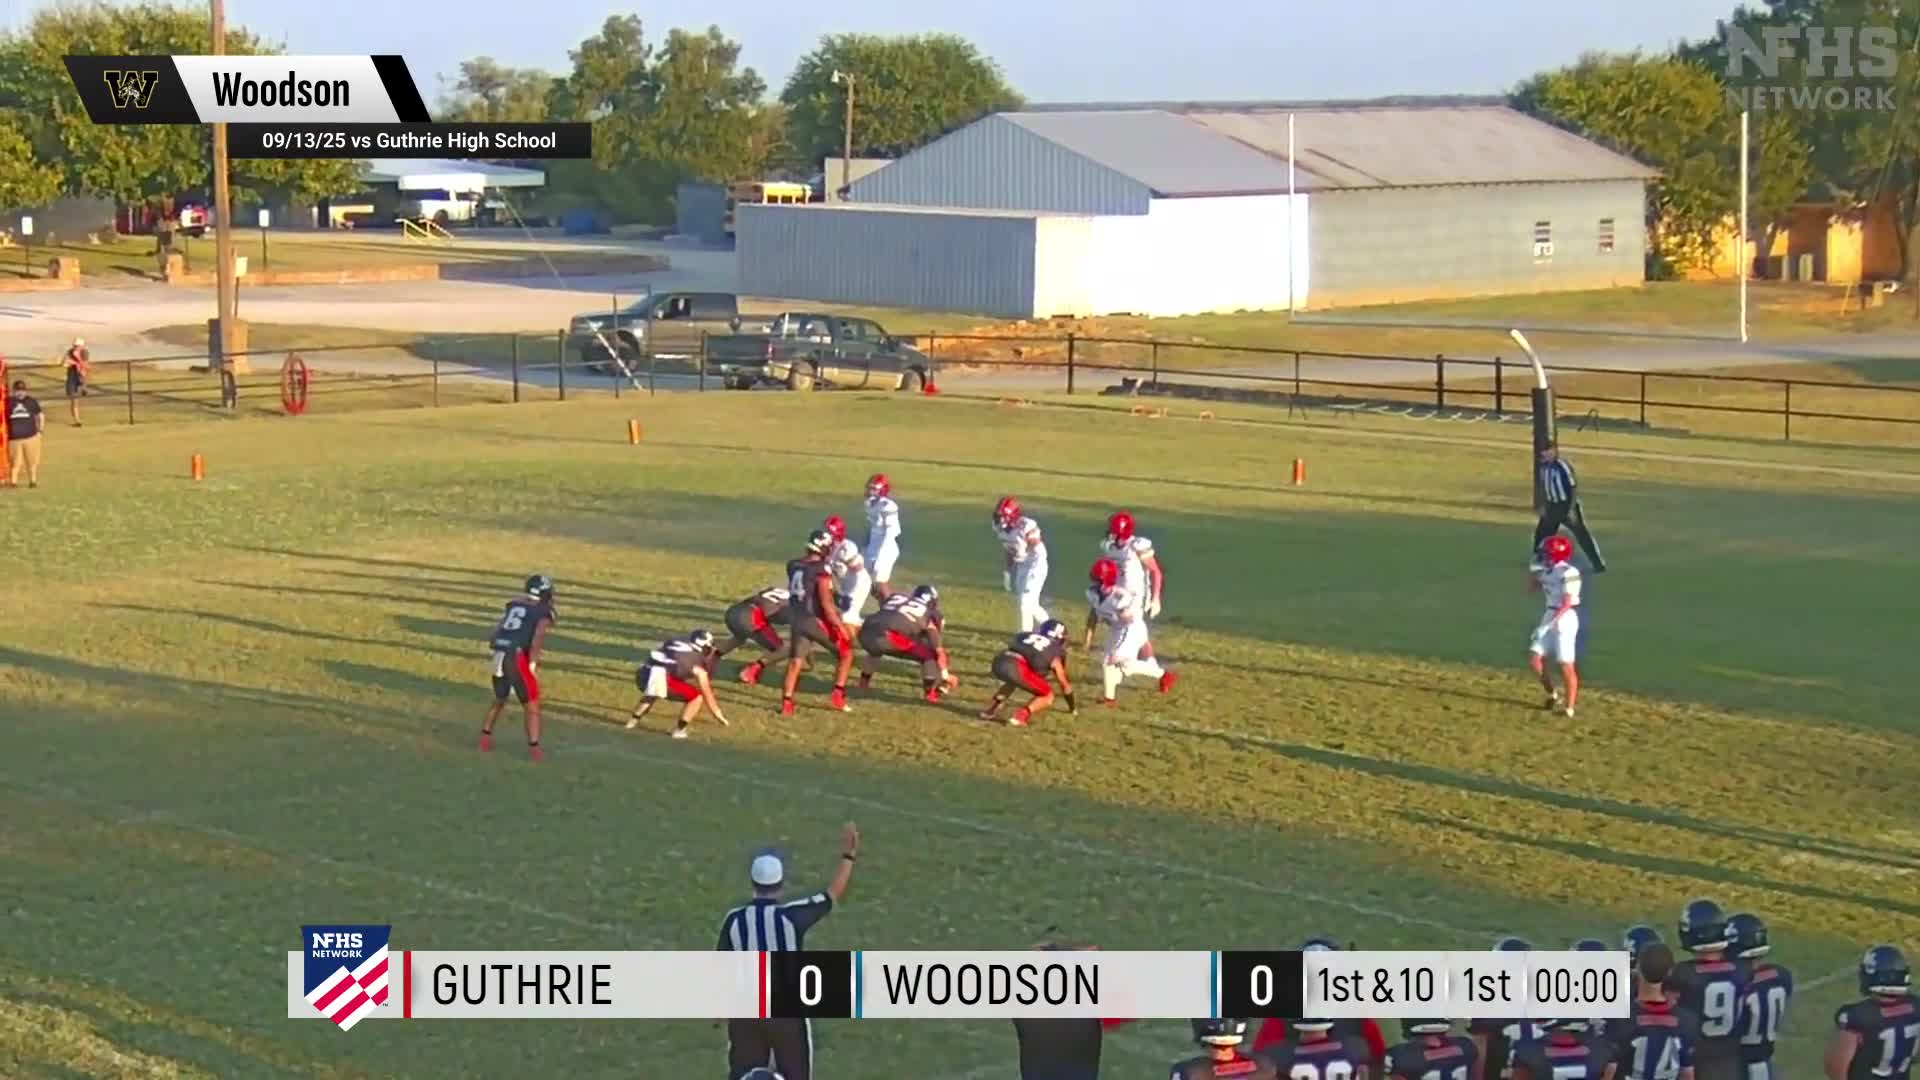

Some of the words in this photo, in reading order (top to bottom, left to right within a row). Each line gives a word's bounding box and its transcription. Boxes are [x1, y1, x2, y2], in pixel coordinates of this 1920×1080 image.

[790, 570, 806, 601] 4
[503, 606, 527, 630] 6
[1701, 981, 1737, 1037] 9
[1740, 986, 1786, 1045] 10
[1624, 1036, 1683, 1080] 14
